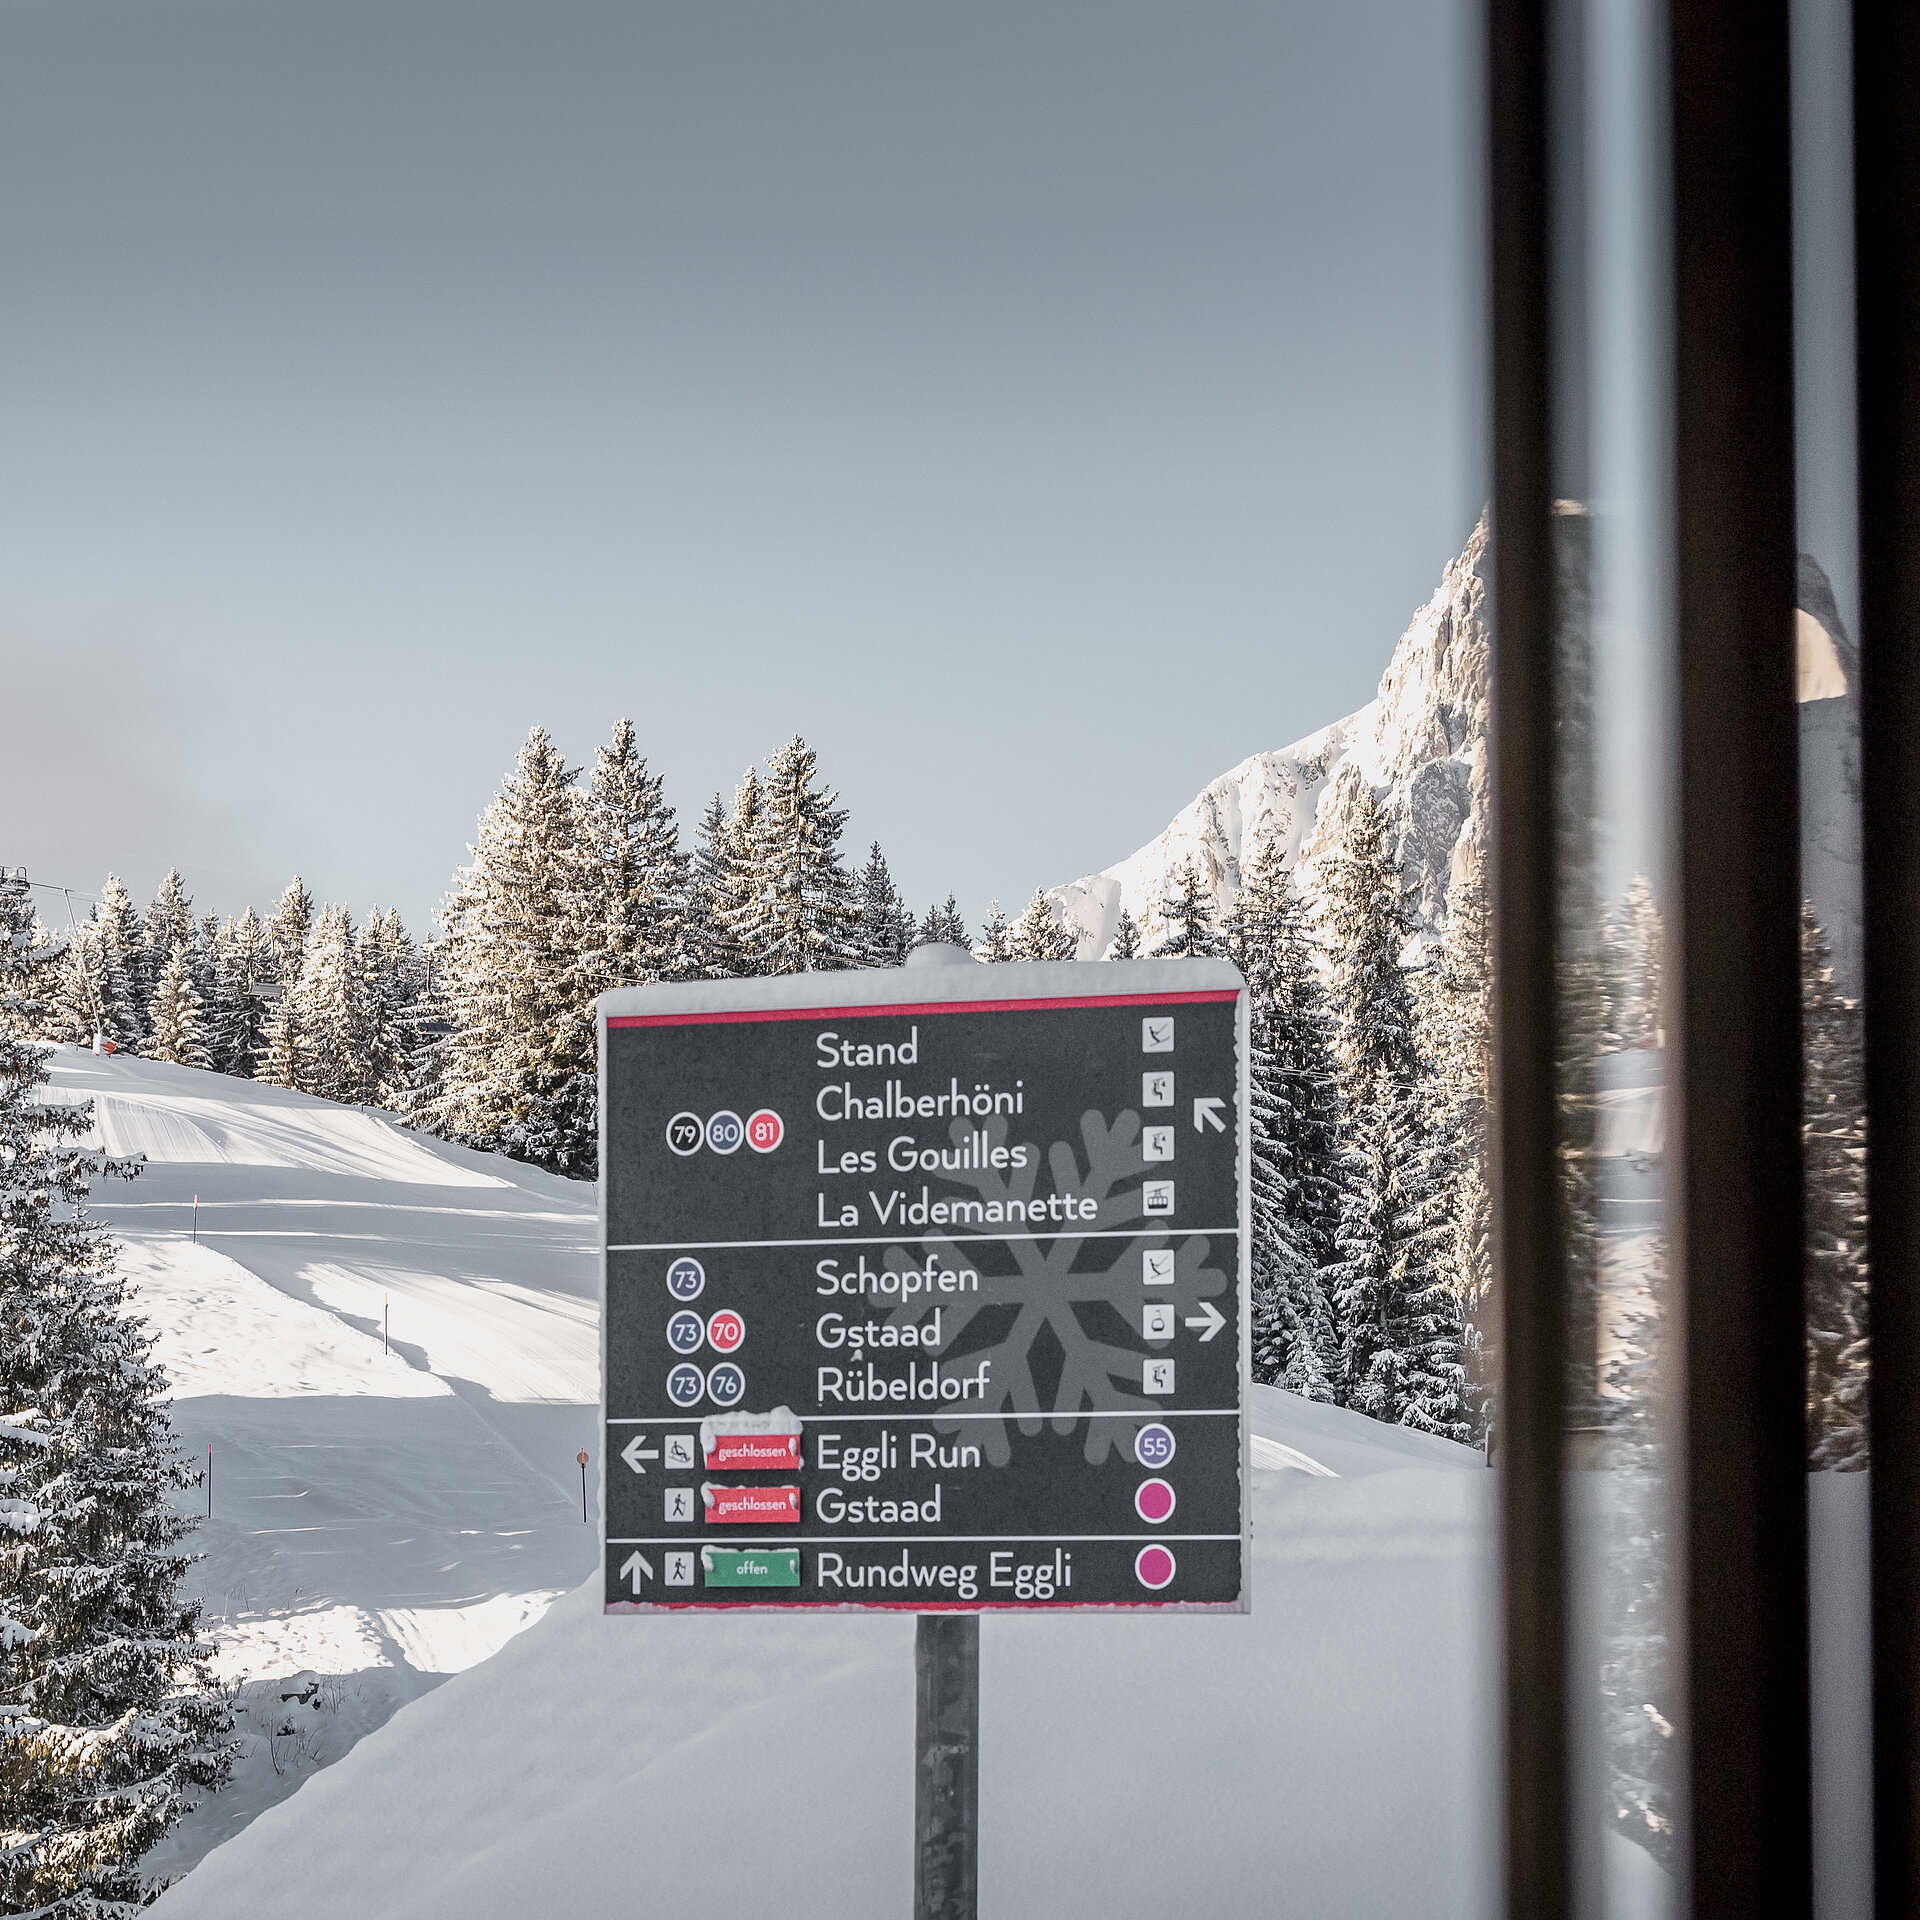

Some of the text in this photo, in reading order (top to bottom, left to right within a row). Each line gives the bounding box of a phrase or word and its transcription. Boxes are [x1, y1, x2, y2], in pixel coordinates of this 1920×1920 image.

[816, 1026, 918, 1068] Stand
[816, 1077, 1024, 1121] Chalberhöni
[674, 1122, 774, 1144] 79 80 81
[818, 1130, 1028, 1174] Les Gouilles
[818, 1186, 1099, 1227] La Videmanette
[675, 1270, 697, 1289] 73
[816, 1254, 979, 1303] Schopfen
[675, 1322, 738, 1342] 73 70
[816, 1308, 941, 1349] Gstaad
[675, 1376, 737, 1395] 73 76
[817, 1361, 992, 1402] Rübeldorf
[718, 1443, 786, 1462] geschlossen
[817, 1431, 981, 1482] Eggli Run
[1143, 1437, 1168, 1456] 55
[718, 1497, 786, 1515] geschlossen
[816, 1484, 941, 1524] Gstaad
[736, 1560, 768, 1576] offen
[817, 1548, 1072, 1600] Rundweg Eggli
